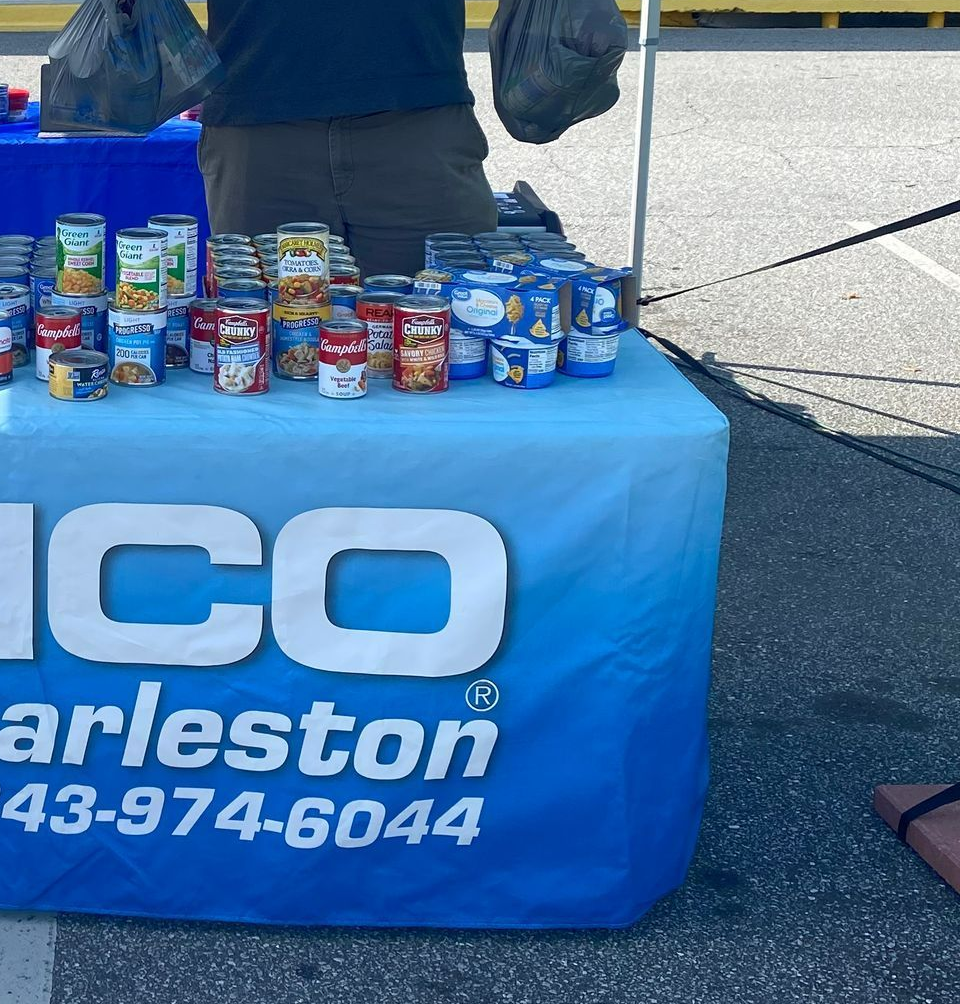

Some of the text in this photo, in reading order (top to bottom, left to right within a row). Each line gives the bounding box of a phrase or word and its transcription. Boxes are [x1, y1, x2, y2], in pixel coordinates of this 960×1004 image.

[61, 229, 89, 238] Green
[64, 237, 89, 247] Giant
[118, 240, 143, 252] Green
[119, 250, 143, 260] Giant
[582, 286, 595, 295] PACK
[365, 307, 393, 317] REA
[466, 305, 498, 317] Original
[282, 317, 319, 329] PROGRESSO
[36, 322, 81, 341] Campbell's
[115, 324, 151, 335] PROGRESSO
[219, 323, 256, 337] CHUNKY
[404, 323, 442, 336] CHUNKY
[320, 337, 366, 356] Campbell's
[116, 348, 130, 359] 200
[400, 349, 424, 358] SAVORY
[330, 375, 357, 384] Vegetable
